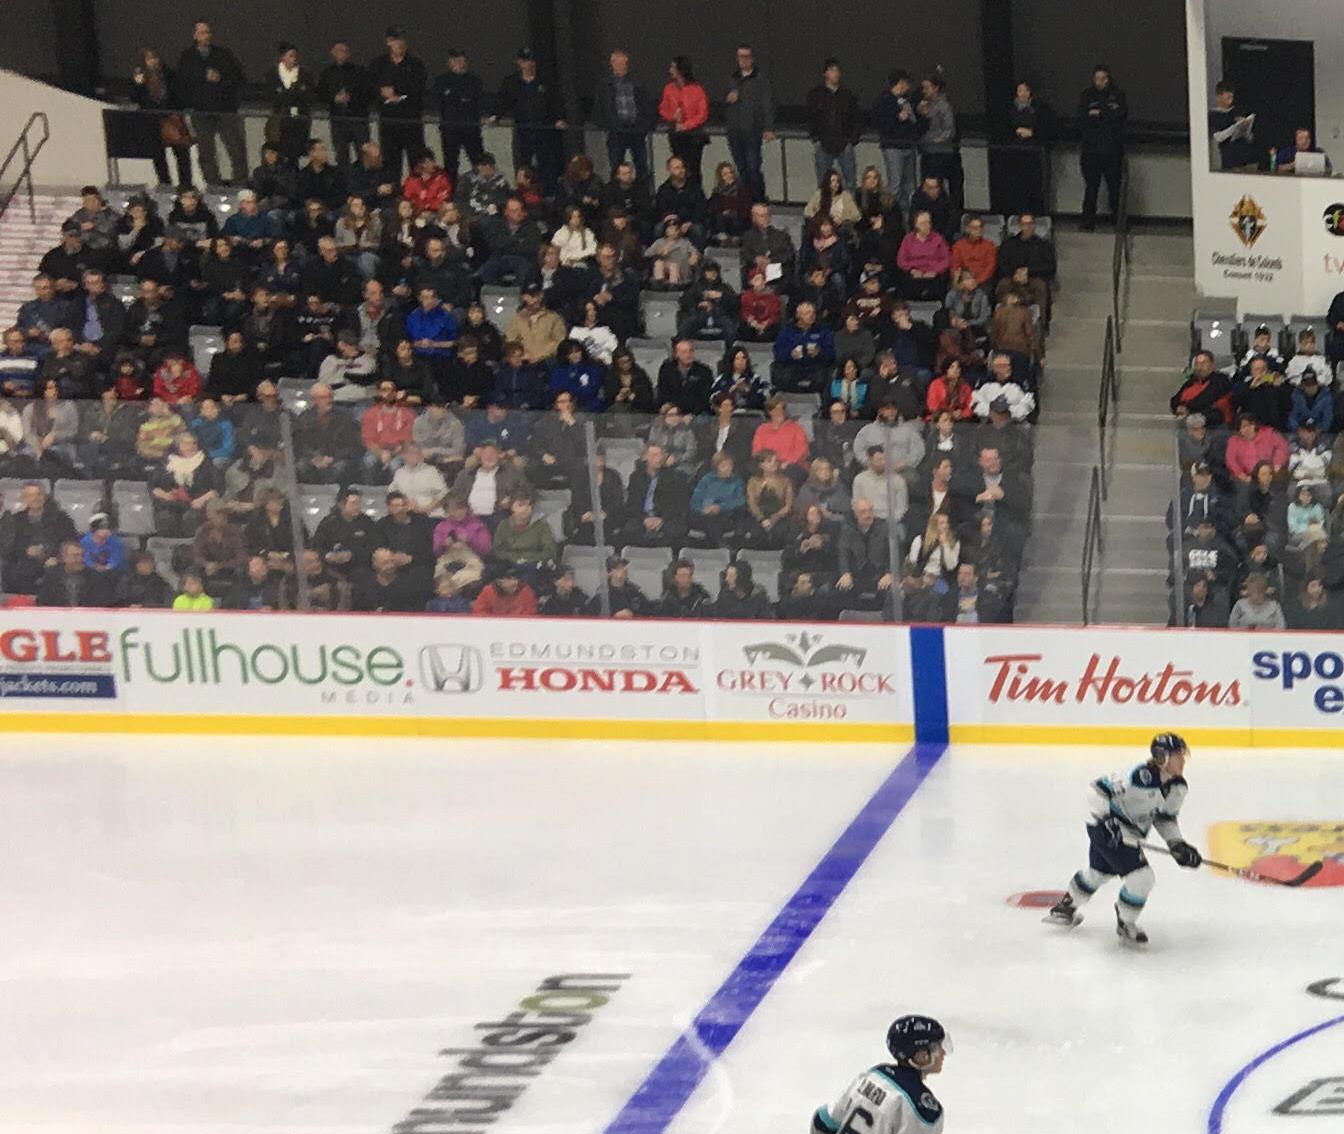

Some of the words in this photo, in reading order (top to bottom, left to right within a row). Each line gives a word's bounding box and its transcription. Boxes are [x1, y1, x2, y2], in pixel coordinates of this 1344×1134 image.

[490, 641, 700, 661] EDMUNDSTON
[499, 667, 699, 695] HONDA
[716, 669, 792, 692] GREY
[821, 671, 896, 694] ROCK
[984, 653, 1066, 704] Tim
[1076, 653, 1243, 706] Hortons
[321, 691, 417, 705] MEDIA
[768, 698, 847, 720] Casino
